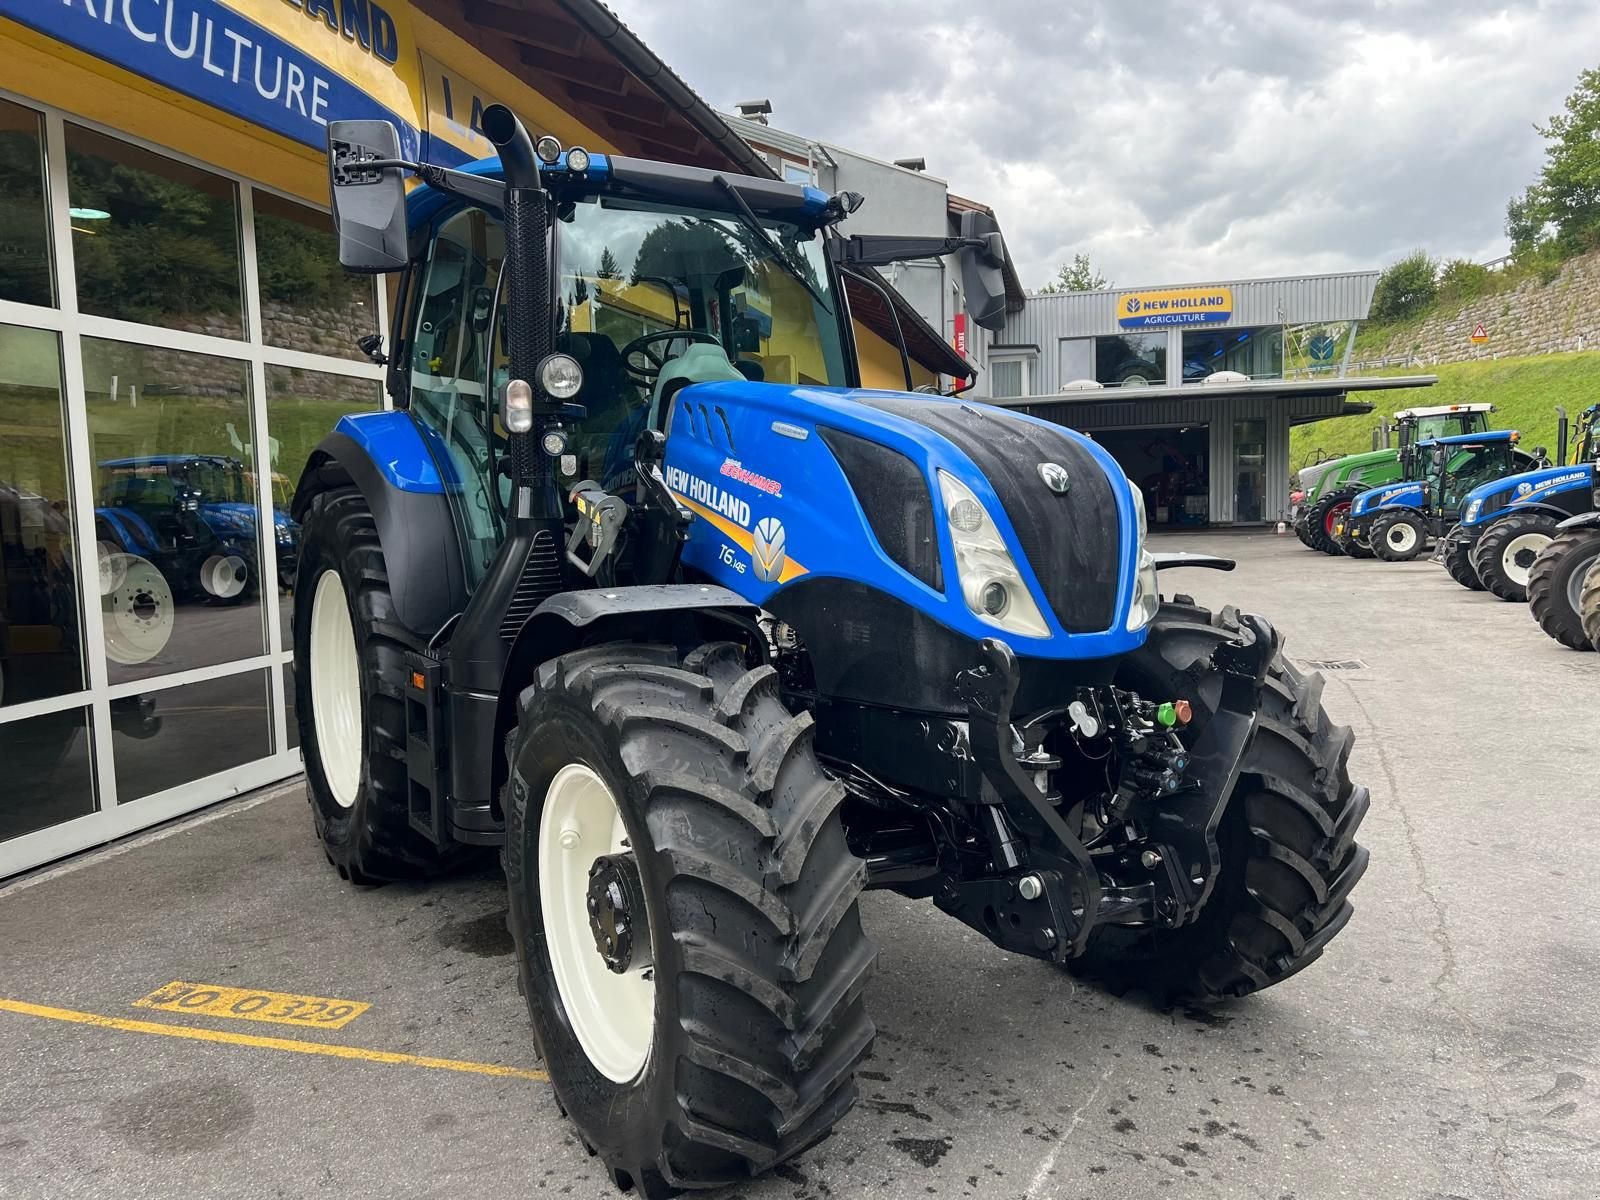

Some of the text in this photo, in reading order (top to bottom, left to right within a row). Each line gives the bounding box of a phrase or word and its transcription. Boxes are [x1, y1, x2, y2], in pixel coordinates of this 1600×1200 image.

[1144, 296, 1224, 310] NEW HOLLAND
[1144, 313, 1206, 325] AGRICULTURE
[1535, 471, 1586, 490] NEW HOLLAND
[665, 465, 688, 494] NEW
[690, 473, 751, 527] HOLLAND
[718, 544, 747, 574] T6.145
[267, 1000, 354, 1022] 329
